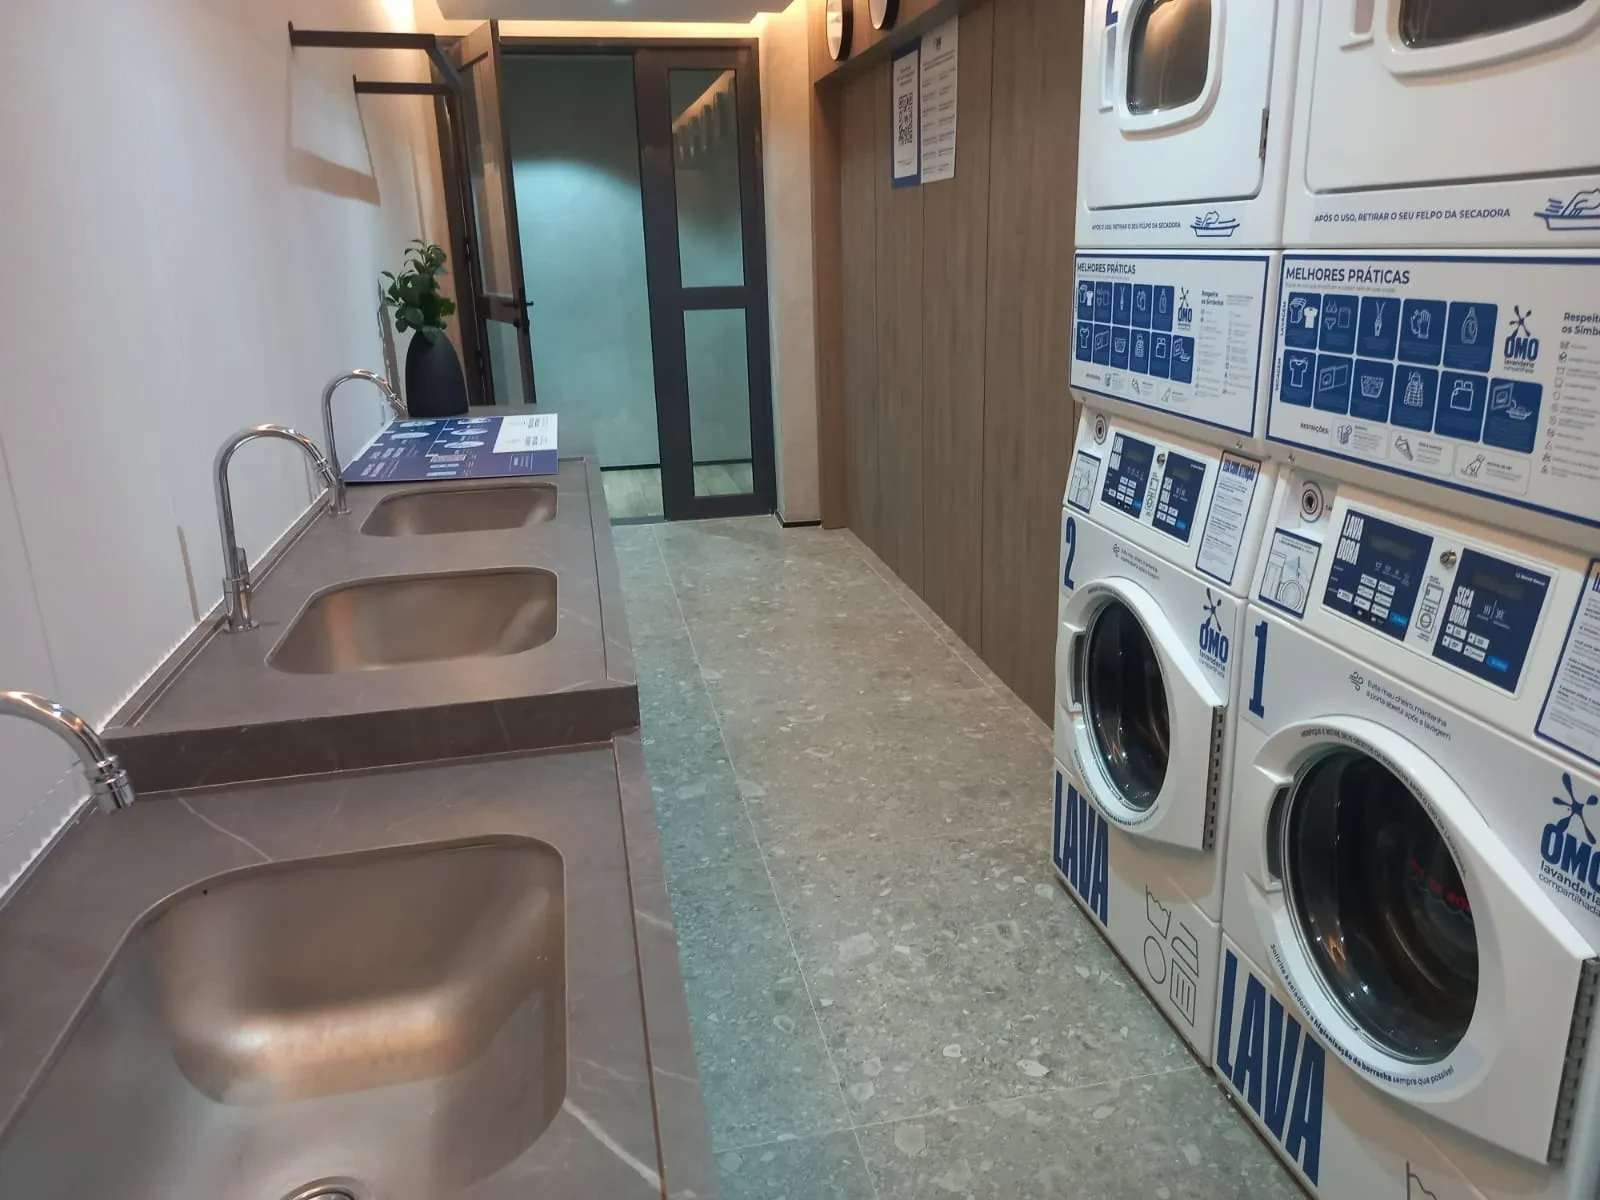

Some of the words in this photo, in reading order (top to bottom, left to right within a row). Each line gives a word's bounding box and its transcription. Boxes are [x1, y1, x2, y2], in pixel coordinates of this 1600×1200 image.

[1314, 212, 1333, 222] APÓS
[1341, 213, 1357, 222] USO,
[1358, 213, 1389, 221] RETIRAR
[1391, 212, 1397, 220] O
[1399, 211, 1414, 220] SEU
[1415, 210, 1442, 220] FELPO
[1444, 210, 1457, 219] DA
[1459, 208, 1511, 219] SECADORA
[1077, 263, 1106, 273] MELHORES
[1107, 261, 1136, 274] PRÁTICAS
[1286, 267, 1345, 282] MELHORES
[1348, 265, 1410, 284] PRÁTICAS
[1178, 307, 1193, 323] OMO
[1561, 326, 1573, 334] os
[1503, 335, 1540, 362] OMO
[1342, 513, 1365, 541] LAVA
[1064, 516, 1077, 591] 2
[1336, 537, 1361, 566] DORA
[1448, 604, 1471, 628] DORA
[1199, 620, 1229, 664] OMO
[1249, 620, 1268, 720] 1
[1367, 680, 1381, 692] Evite
[1381, 689, 1395, 700] mau
[1395, 695, 1415, 711] cheiro,
[1414, 706, 1447, 728] mantenha
[1370, 693, 1386, 705] porta
[1386, 700, 1404, 716] aberta
[1404, 711, 1419, 723] após
[1423, 720, 1451, 741] lavagem
[1053, 768, 1109, 929] LAVA
[1540, 823, 1600, 895] OMO
[1538, 872, 1600, 918] compartilhada
[1540, 860, 1600, 907] lavanderia
[1270, 943, 1286, 974] Solicite
[1287, 981, 1311, 1017] zeladoria
[1313, 1019, 1353, 1061] higienização
[1352, 1056, 1362, 1067] da
[1361, 1061, 1392, 1082] borracha
[1392, 1075, 1418, 1087] sempre
[1417, 1076, 1431, 1087] que
[1430, 1065, 1455, 1085] possível
[1216, 947, 1327, 1188] LAVA
